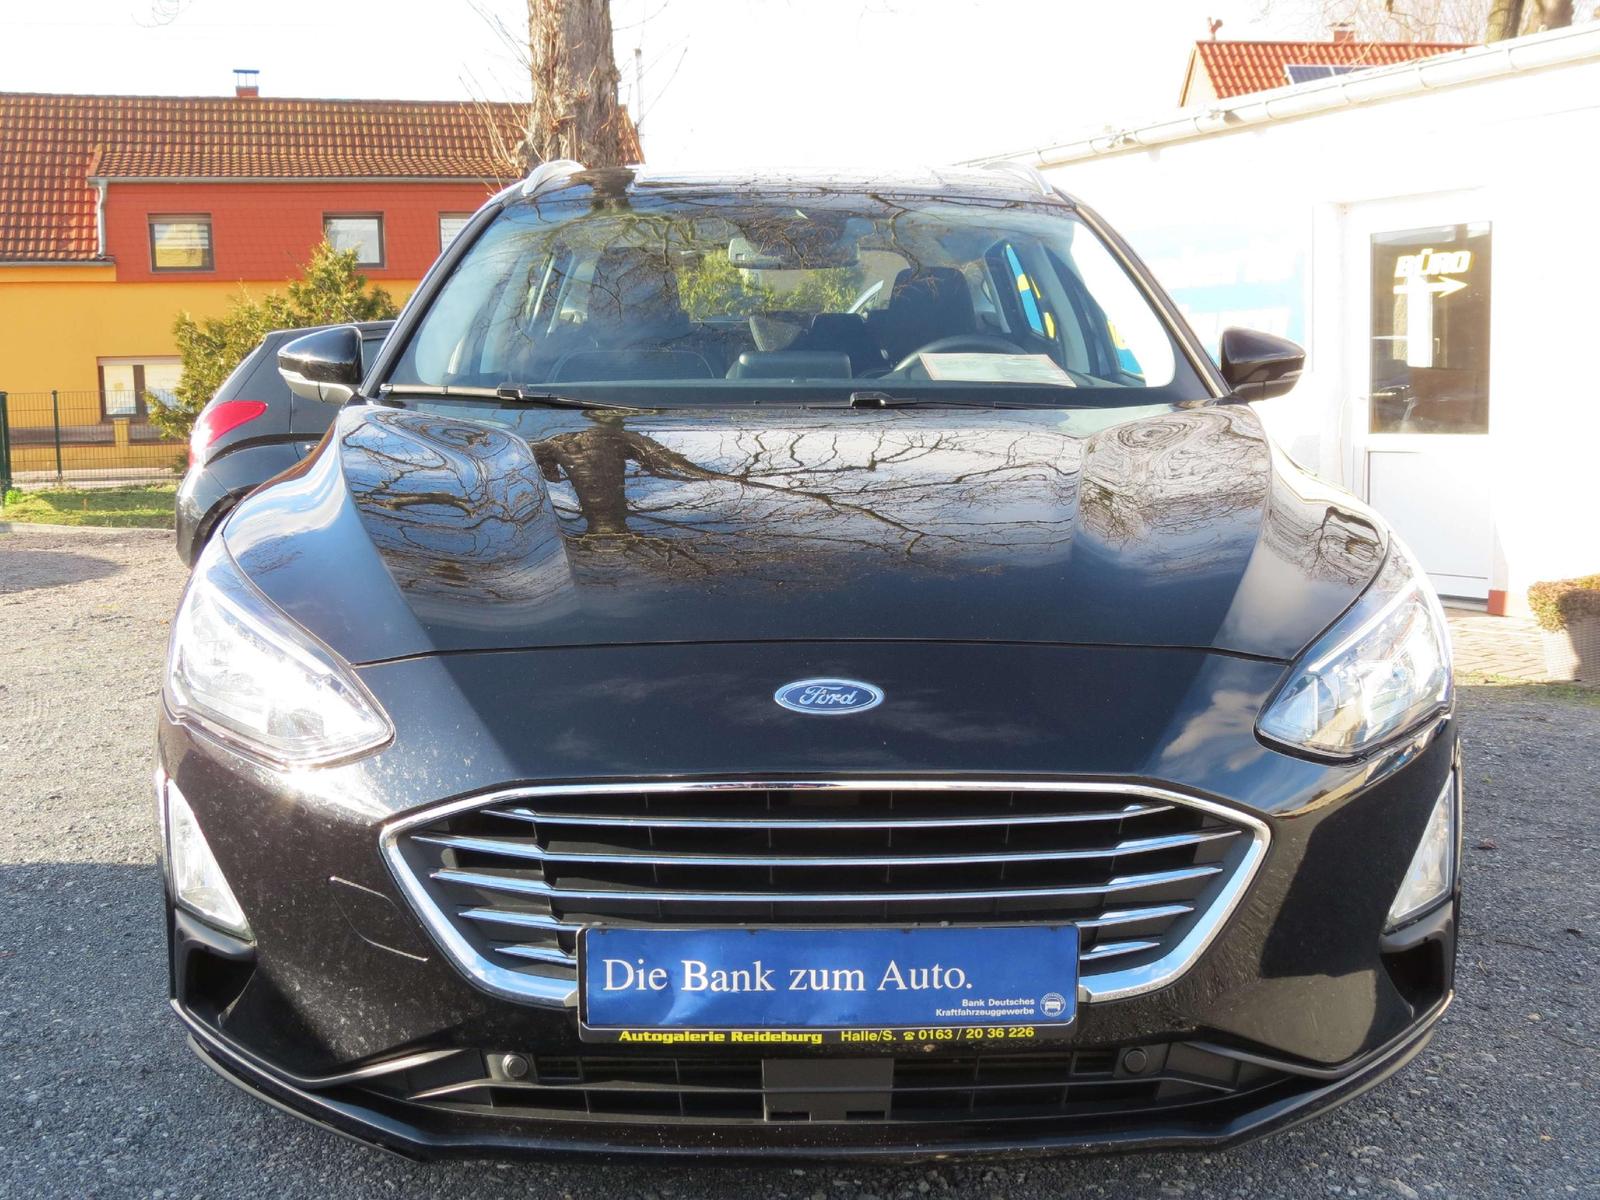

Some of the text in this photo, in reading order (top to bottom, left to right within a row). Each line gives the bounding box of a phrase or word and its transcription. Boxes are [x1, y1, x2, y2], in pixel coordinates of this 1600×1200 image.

[799, 685, 858, 705] Ford
[602, 958, 973, 992] Die Bank zum Auto.
[962, 998, 1035, 1007] Bank Deutsches
[936, 1007, 1035, 1017] Kraftfahrzeuggewerbe
[619, 1030, 725, 1044] Autogalerie
[731, 1030, 823, 1044] Reideburg
[841, 1029, 897, 1042] Halle/S.
[918, 1028, 953, 1041] 0163
[966, 1027, 984, 1039] 20
[987, 1027, 1005, 1038] 36
[1008, 1026, 1035, 1038] 226
